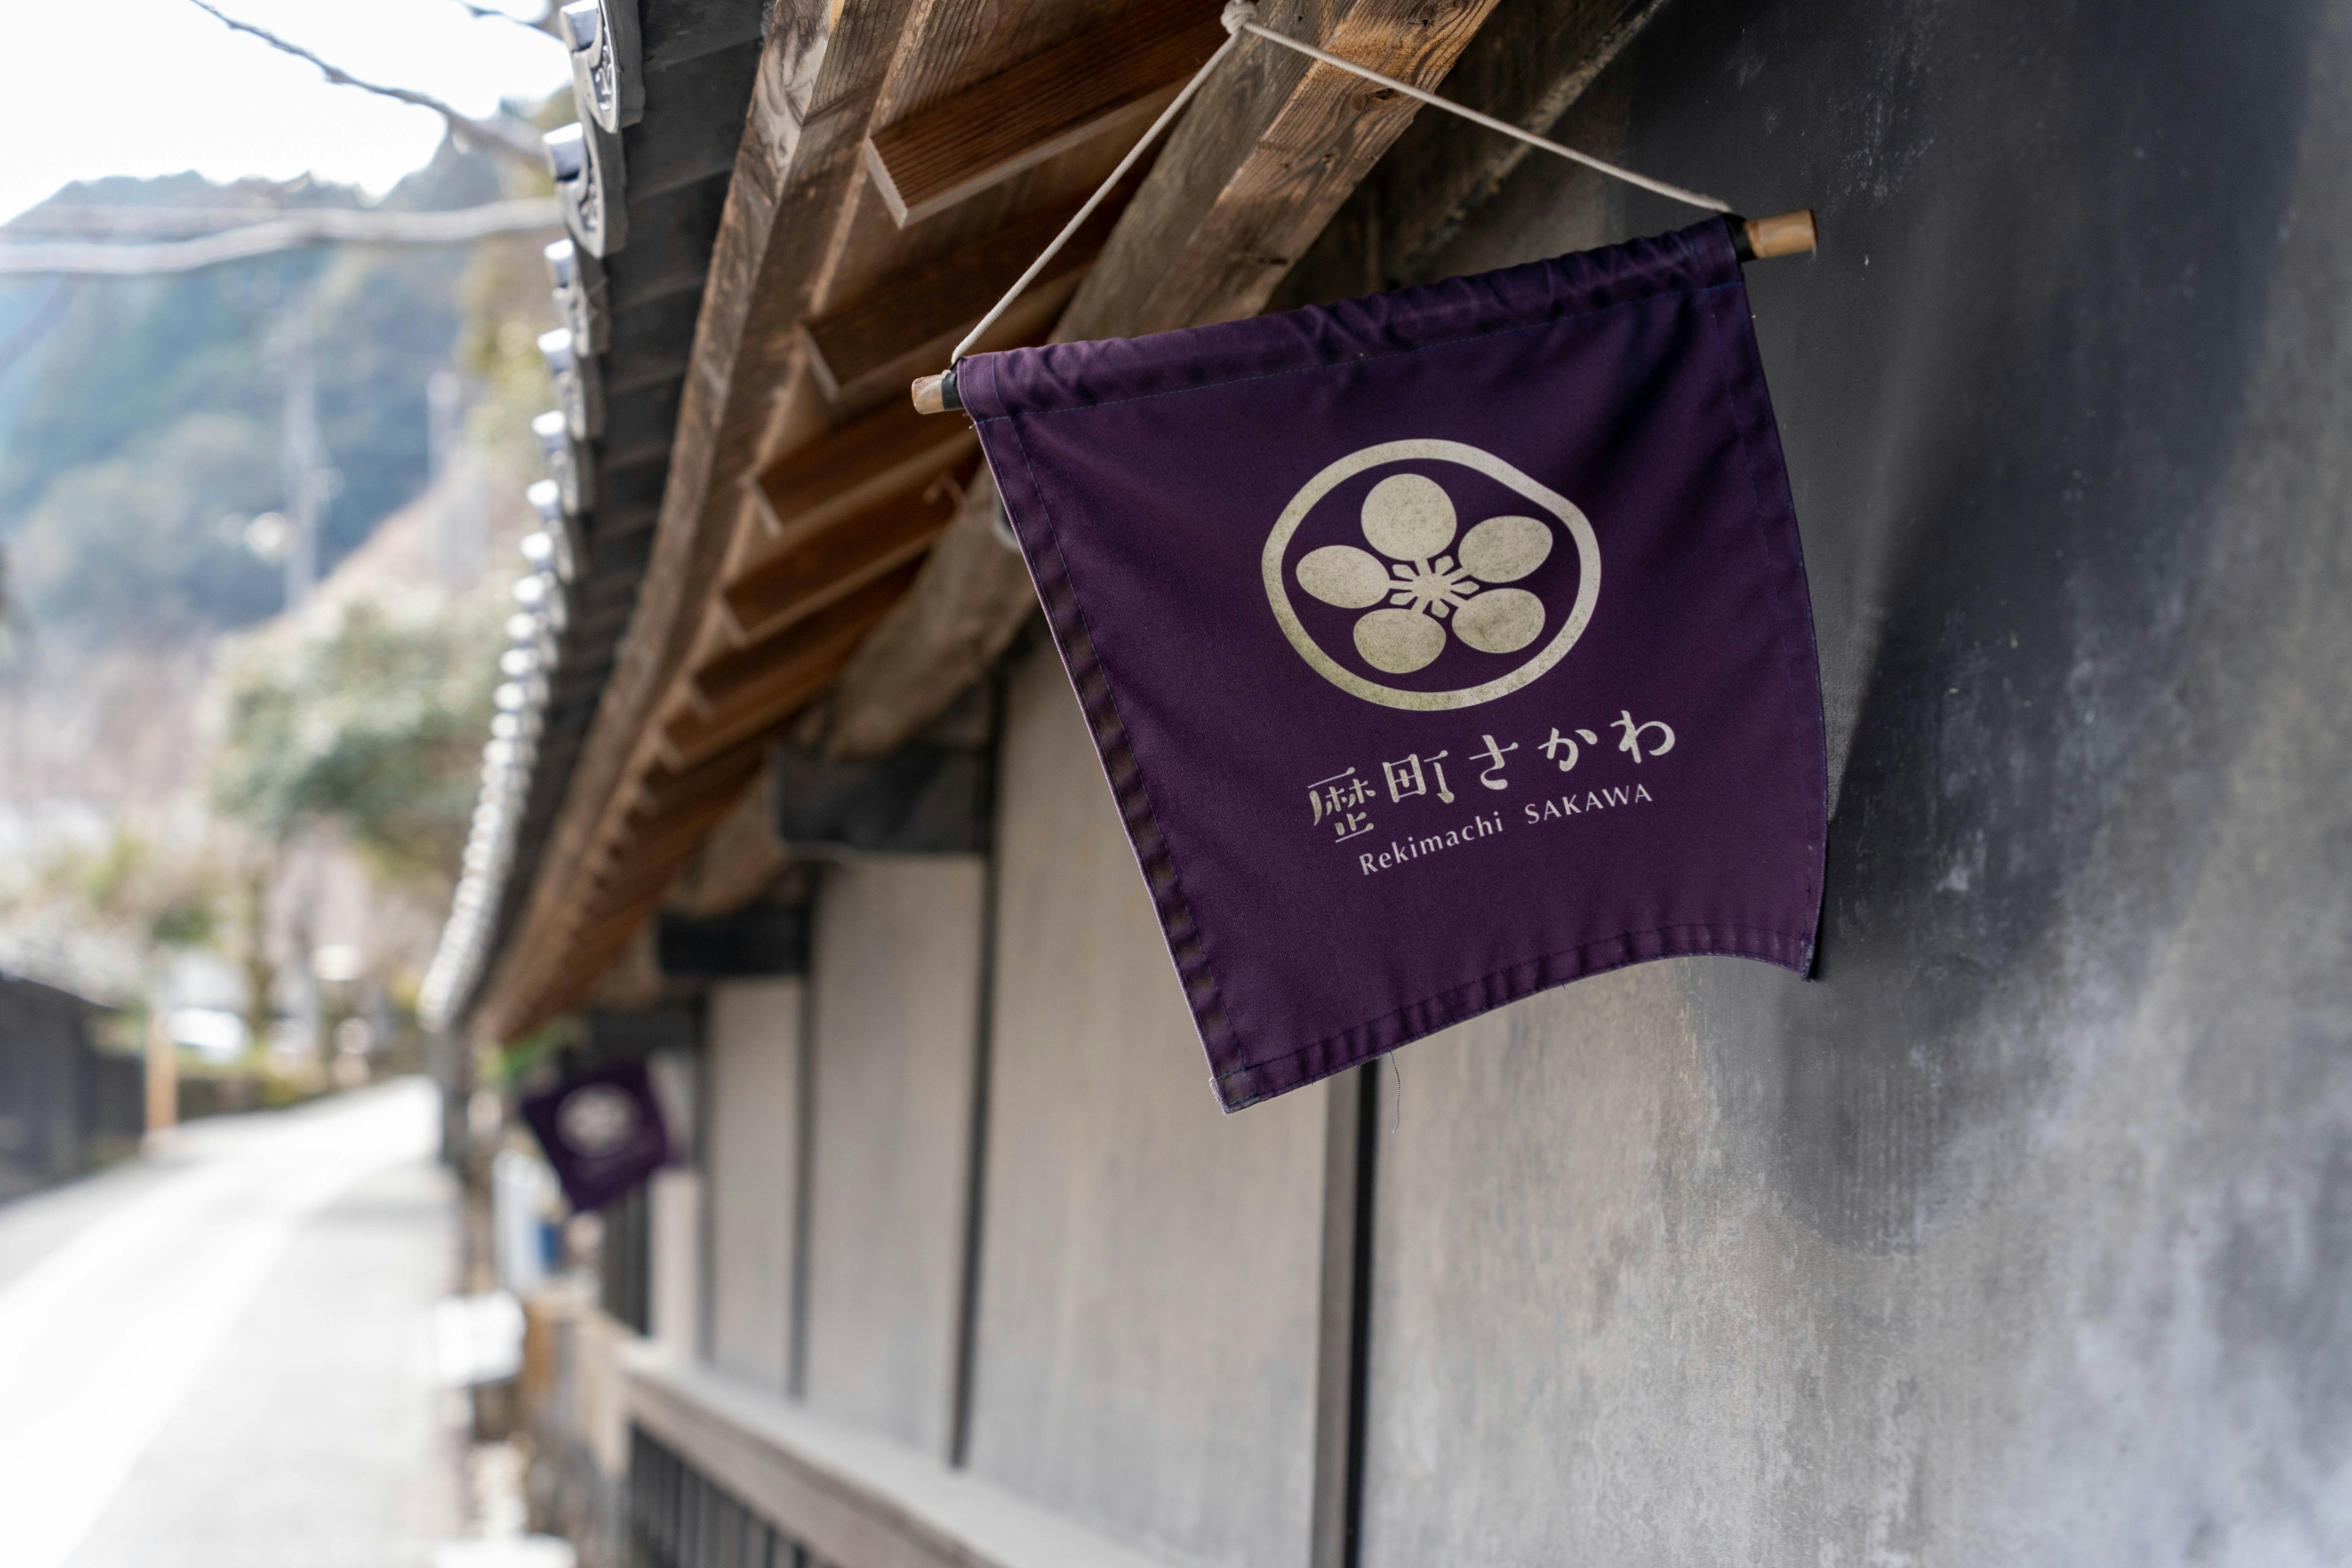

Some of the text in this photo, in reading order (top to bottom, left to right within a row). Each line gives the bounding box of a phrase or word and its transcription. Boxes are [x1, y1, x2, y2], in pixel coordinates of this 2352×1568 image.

[1307, 710, 1675, 843] 歴町さかわ
[1359, 783, 1653, 875] Rekimachi SAKAWA
